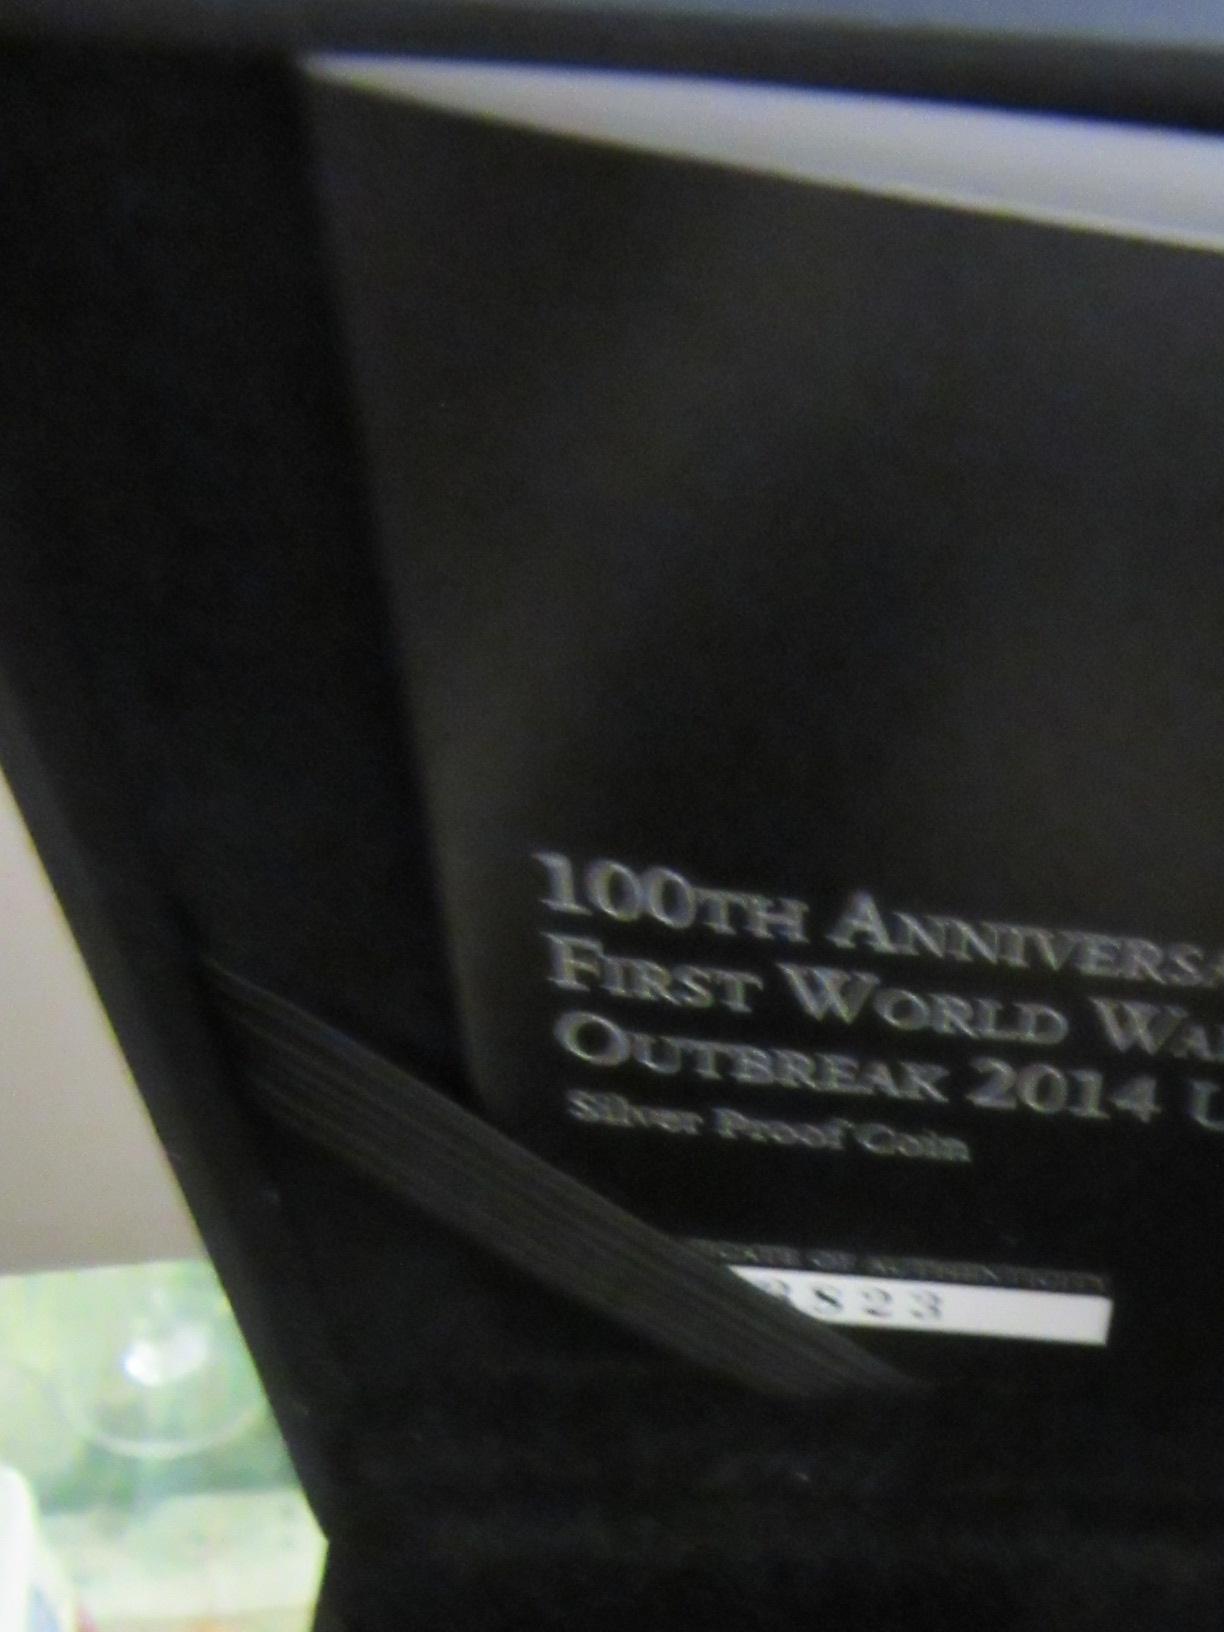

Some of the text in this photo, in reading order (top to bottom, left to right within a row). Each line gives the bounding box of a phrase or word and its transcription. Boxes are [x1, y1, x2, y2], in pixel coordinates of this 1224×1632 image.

[534, 852, 809, 943] 100TH
[541, 931, 764, 1014] FIRST
[775, 961, 1069, 1046] WORLD
[554, 1009, 950, 1103] OUTBREAK
[967, 1055, 1162, 1123] 2014
[566, 1089, 972, 1164] Silver Proof Coin
